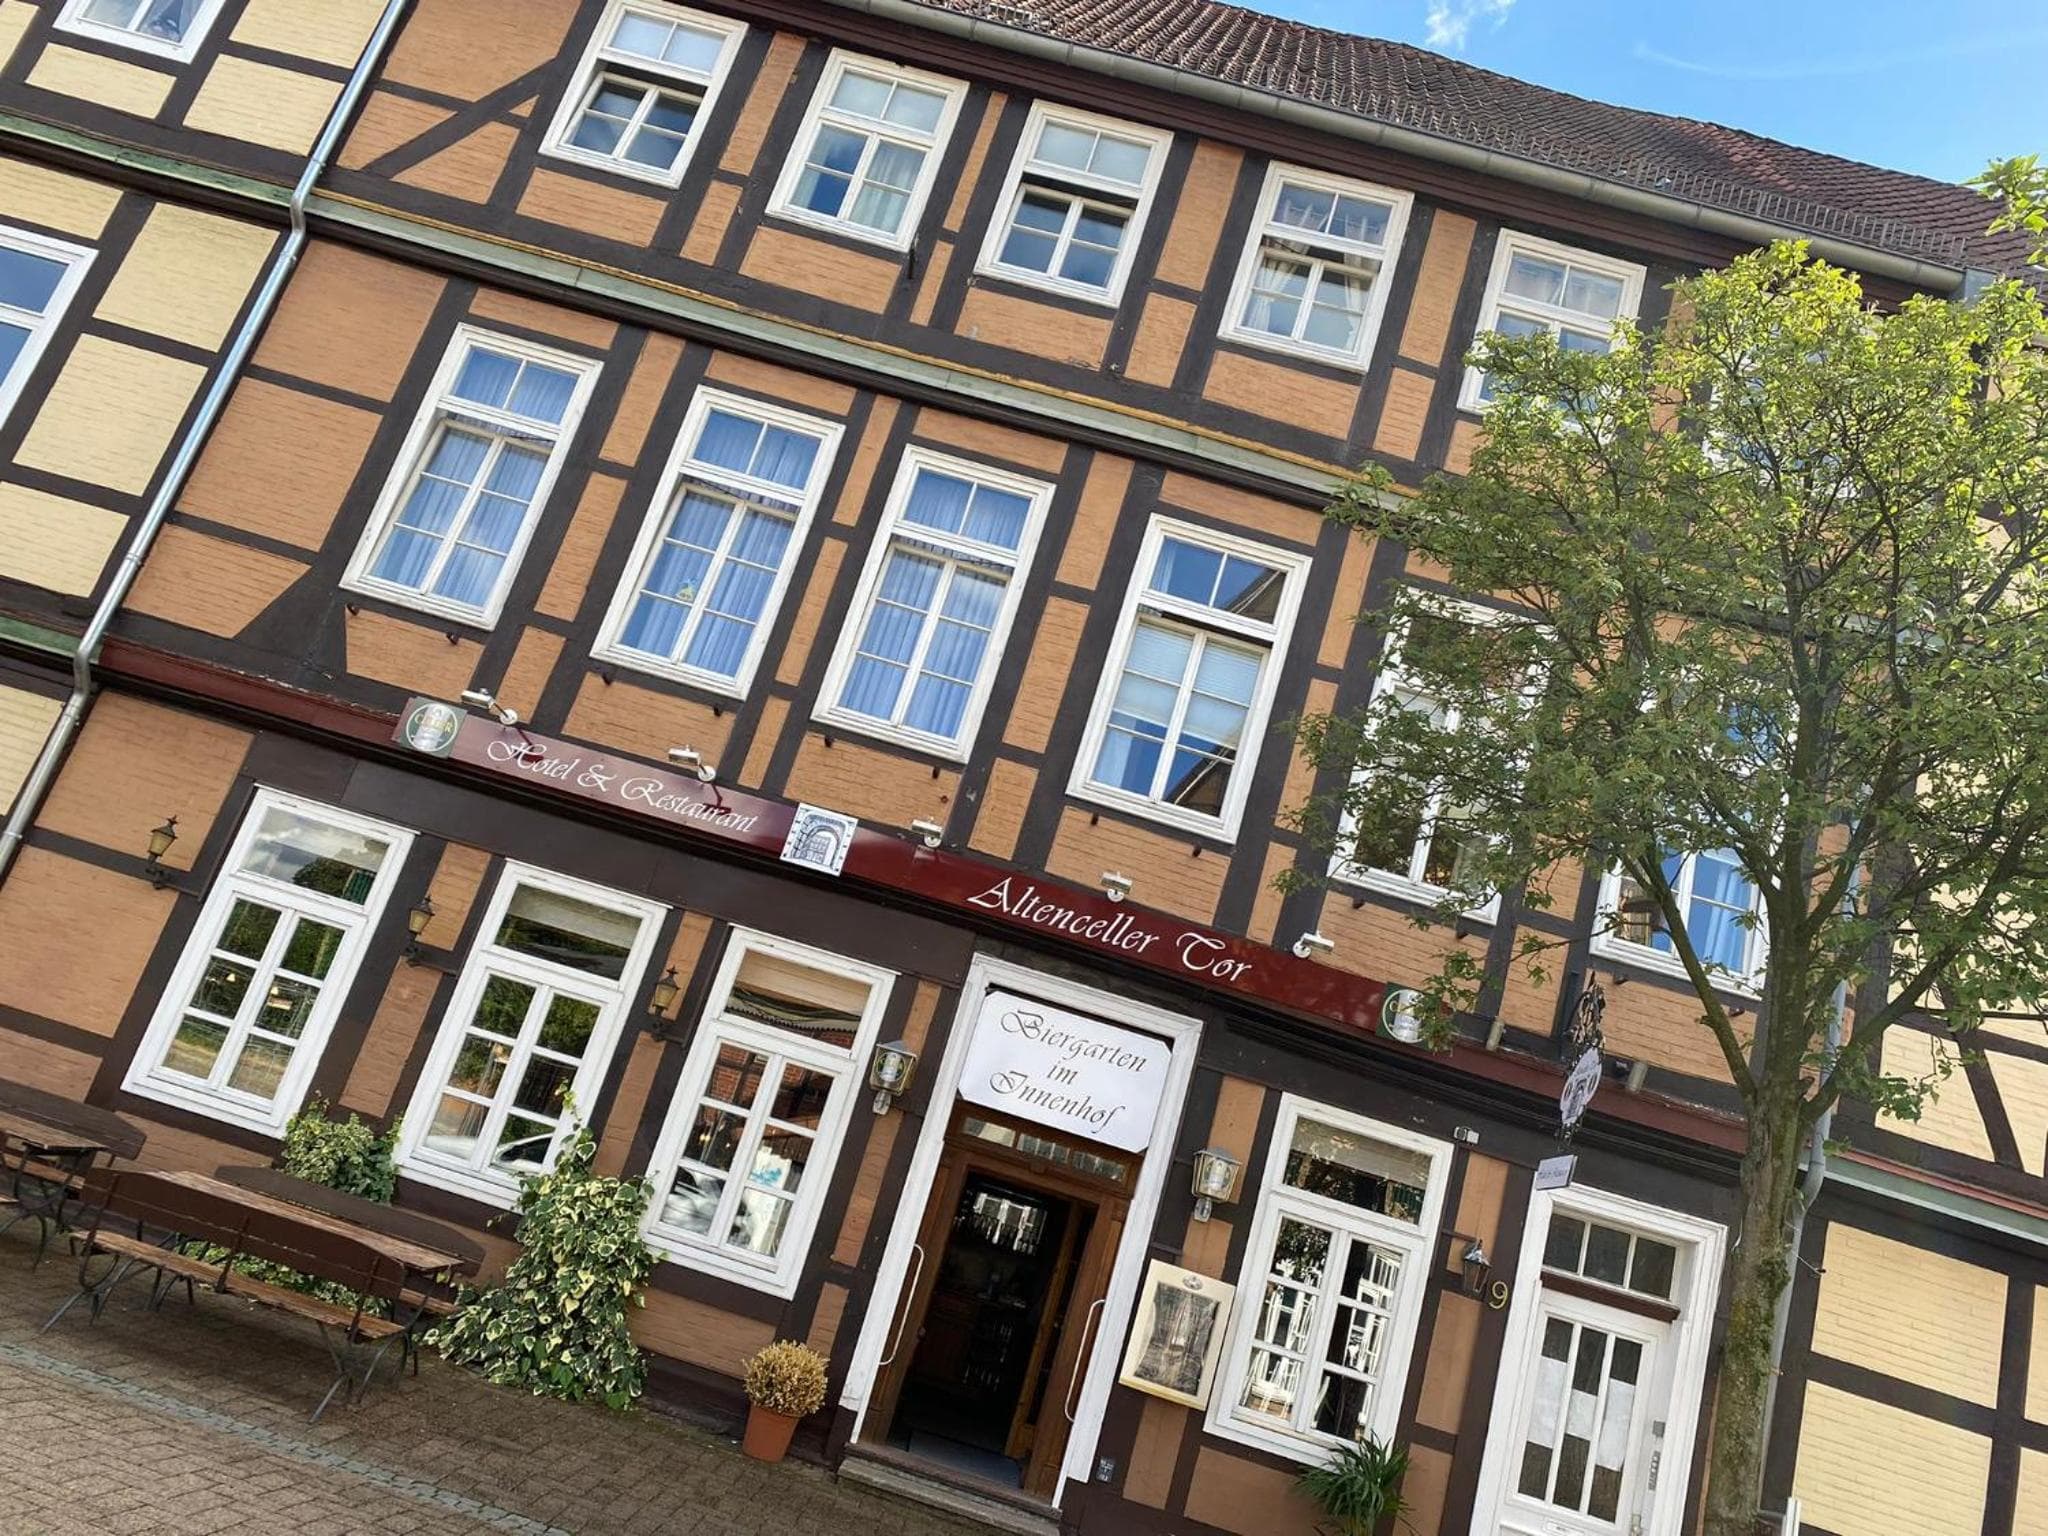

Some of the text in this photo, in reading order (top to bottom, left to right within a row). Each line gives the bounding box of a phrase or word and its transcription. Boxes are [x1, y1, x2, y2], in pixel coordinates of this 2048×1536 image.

[487, 740, 759, 833] Hotel & Restaurant
[966, 876, 1253, 982] Altenceller Tor
[1000, 1009, 1148, 1073] Biergarten
[1046, 1060, 1079, 1086] im
[989, 1070, 1127, 1135] Innenhof
[1489, 1281, 1508, 1309] 9
